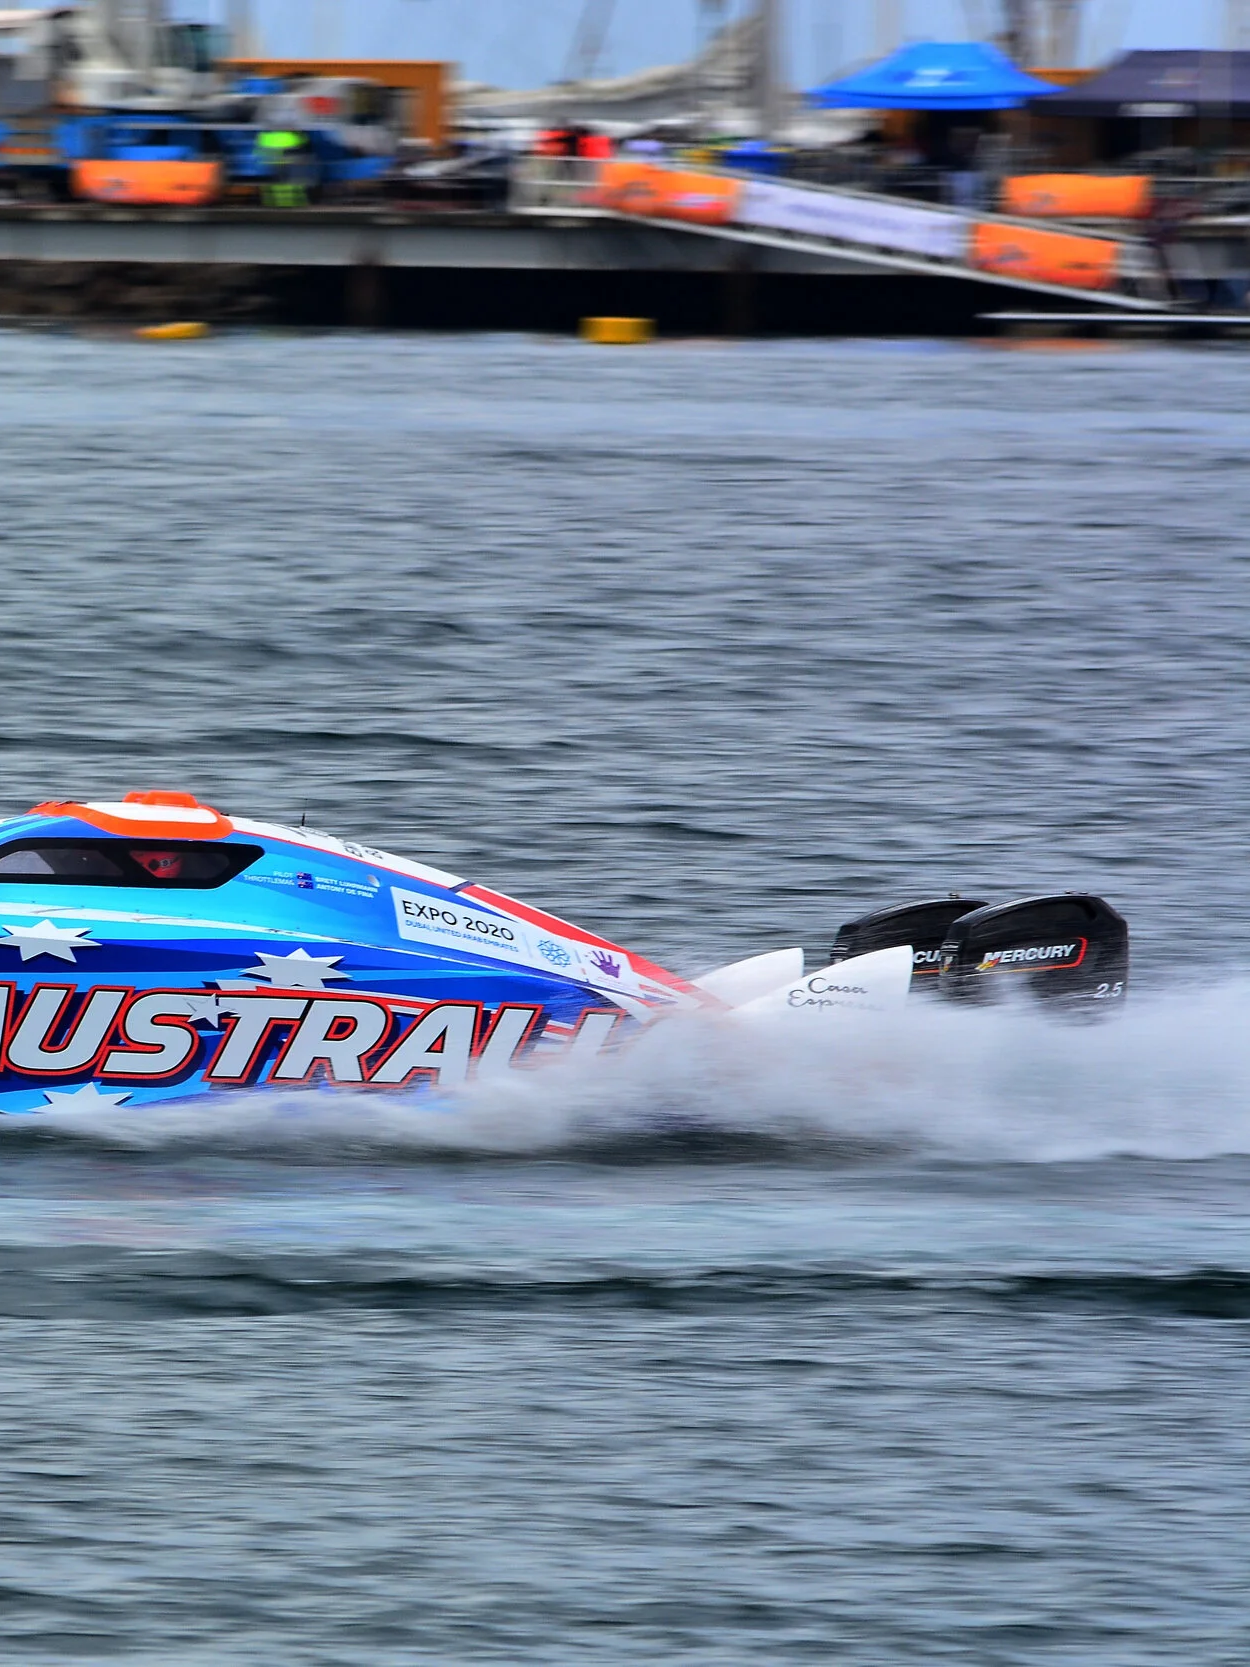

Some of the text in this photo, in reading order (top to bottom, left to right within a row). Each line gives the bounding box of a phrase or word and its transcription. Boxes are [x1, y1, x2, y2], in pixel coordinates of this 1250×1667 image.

[402, 900, 514, 940] EXPO 2020
[982, 944, 1076, 965] MERCURY
[808, 977, 868, 994] Casa
[1094, 982, 1123, 998] 2.5
